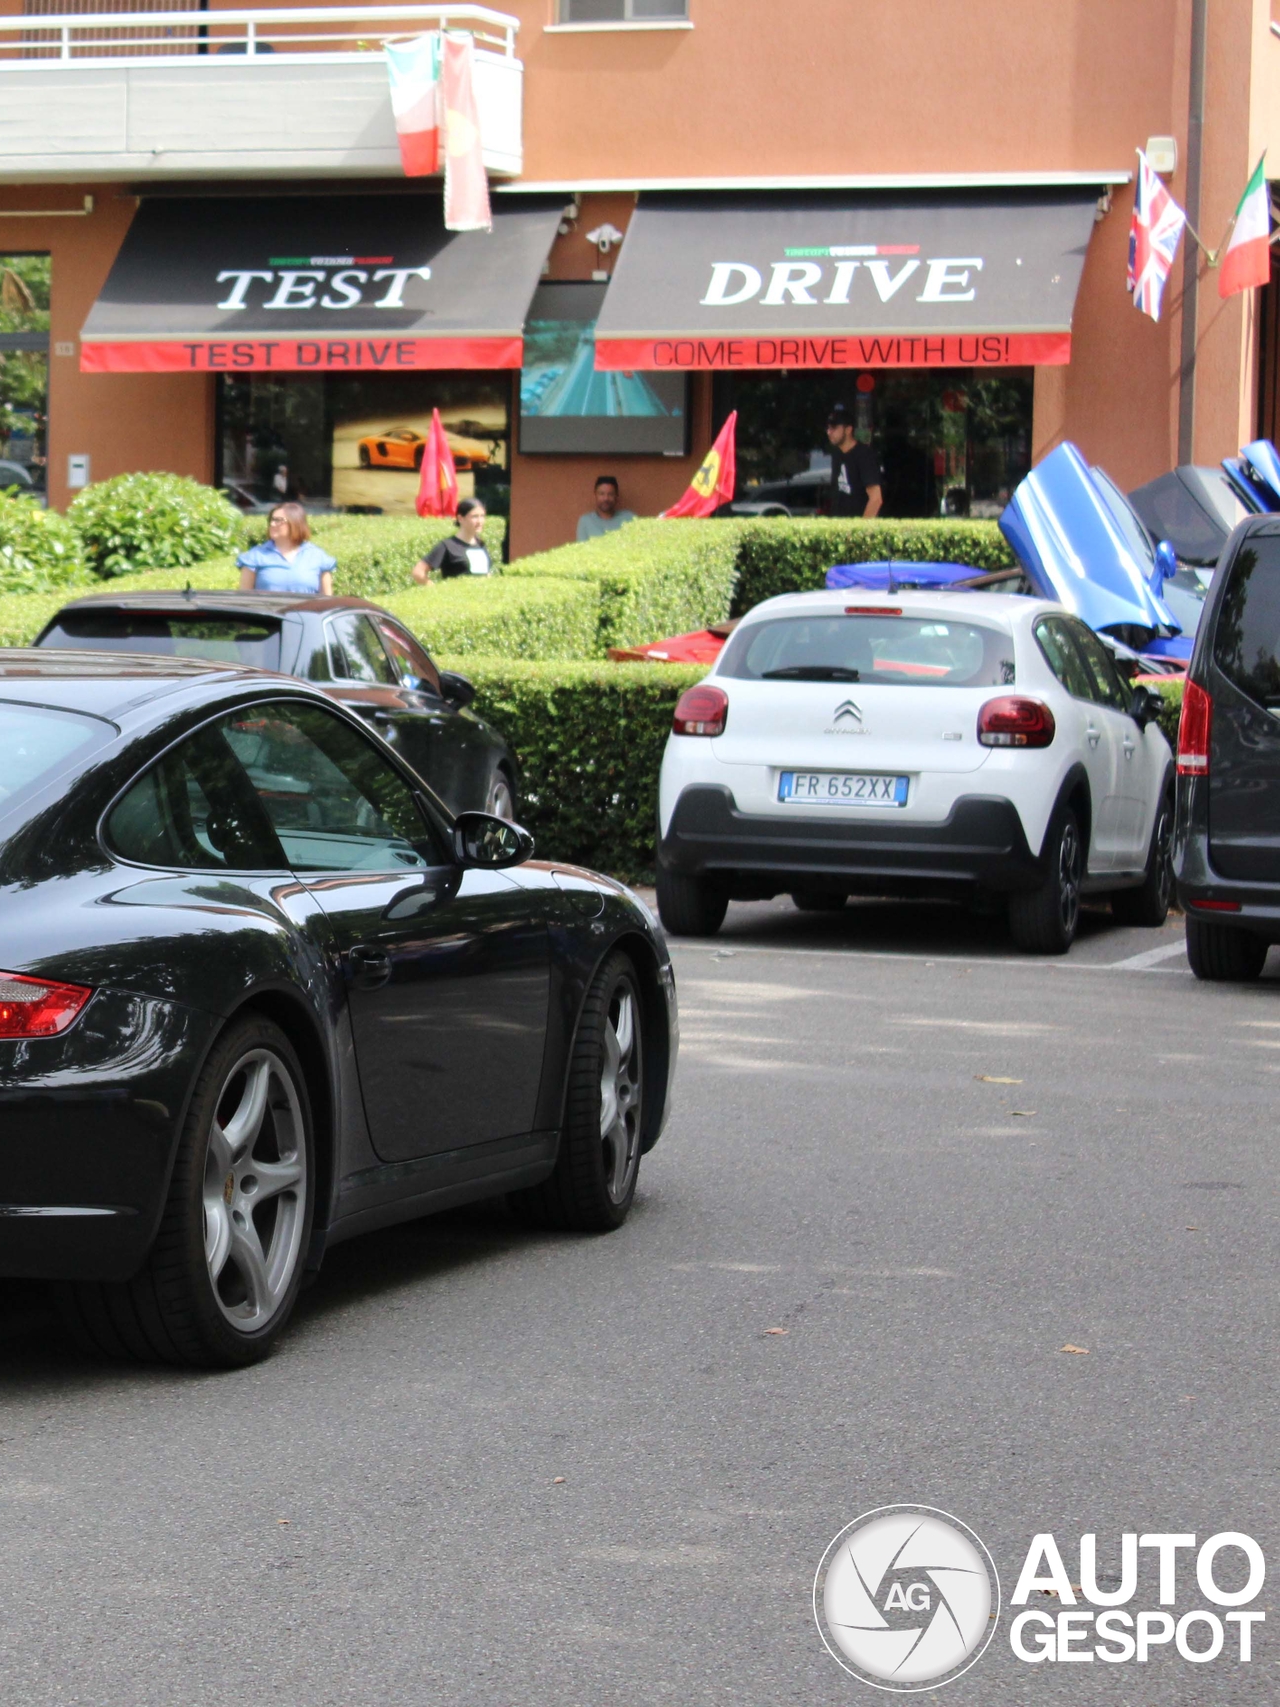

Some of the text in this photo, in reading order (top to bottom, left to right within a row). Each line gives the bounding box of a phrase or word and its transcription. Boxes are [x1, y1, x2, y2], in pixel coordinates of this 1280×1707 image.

[216, 267, 431, 309] TEST
[699, 258, 983, 305] DRIVE
[183, 341, 417, 367] TEST DRIVE
[653, 336, 1010, 366] COME DRIVE WITH US!
[794, 775, 894, 799] FR 652XX
